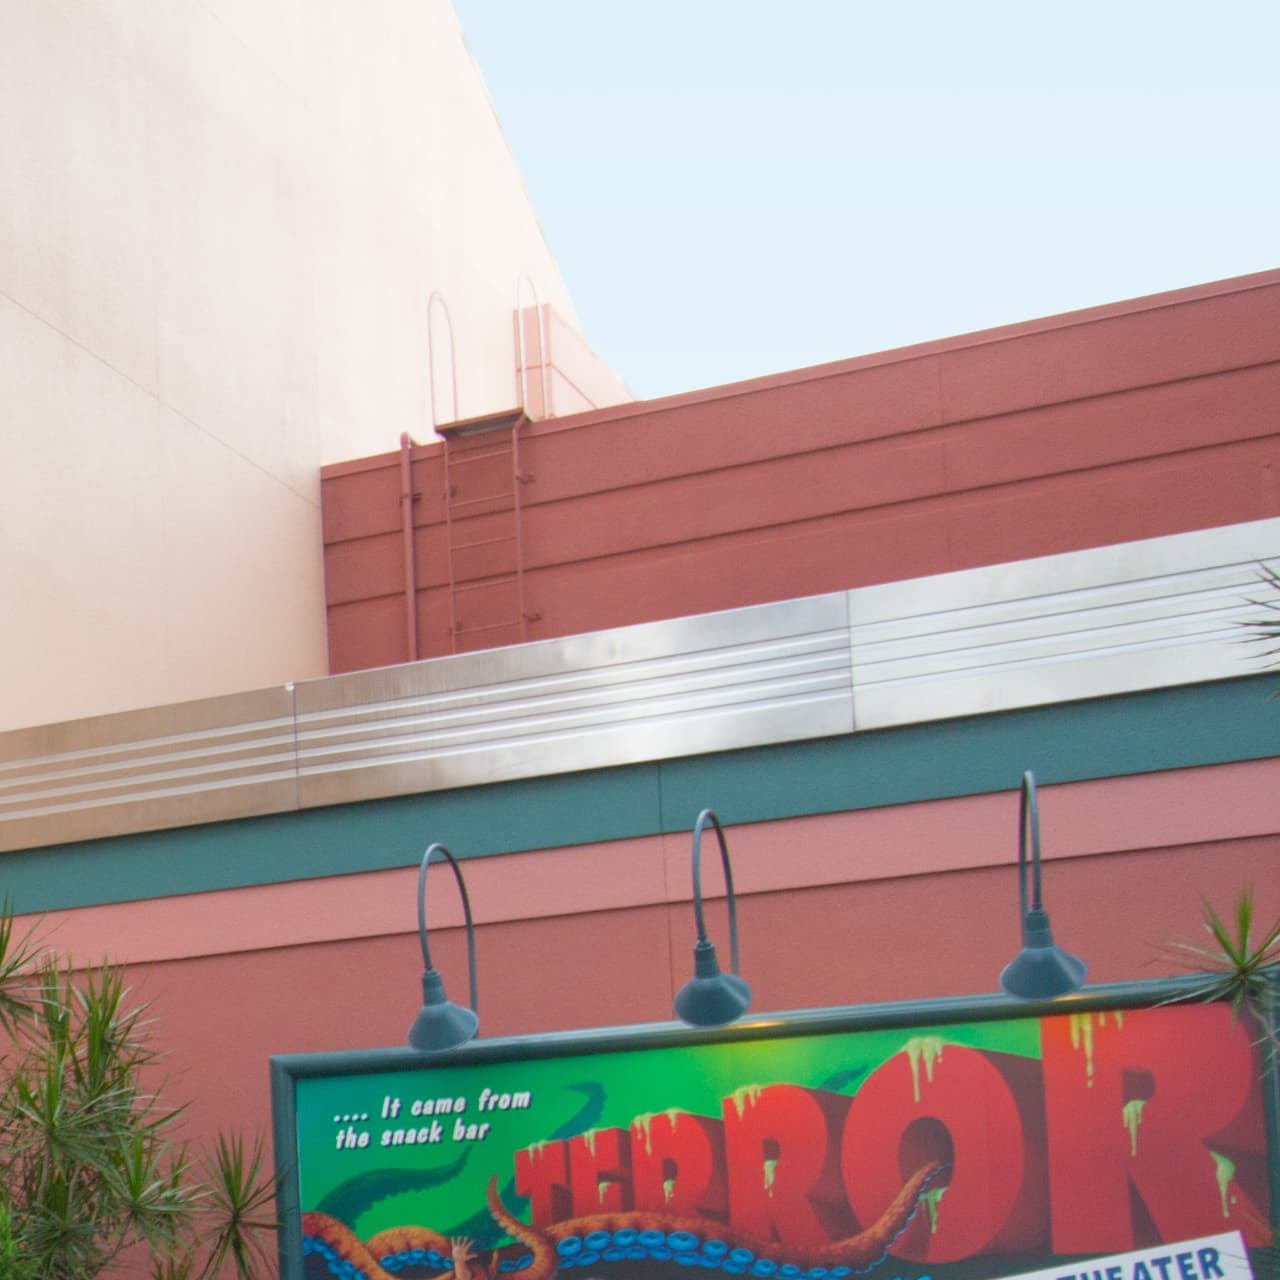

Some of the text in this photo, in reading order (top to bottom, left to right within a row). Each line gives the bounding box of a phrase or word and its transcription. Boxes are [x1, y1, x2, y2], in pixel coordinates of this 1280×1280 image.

[381, 1096, 402, 1119] It
[410, 1096, 467, 1117] came
[478, 1088, 531, 1112] from
[335, 1117, 491, 1150] the snack bar
[515, 1003, 1272, 1263] TERROR
